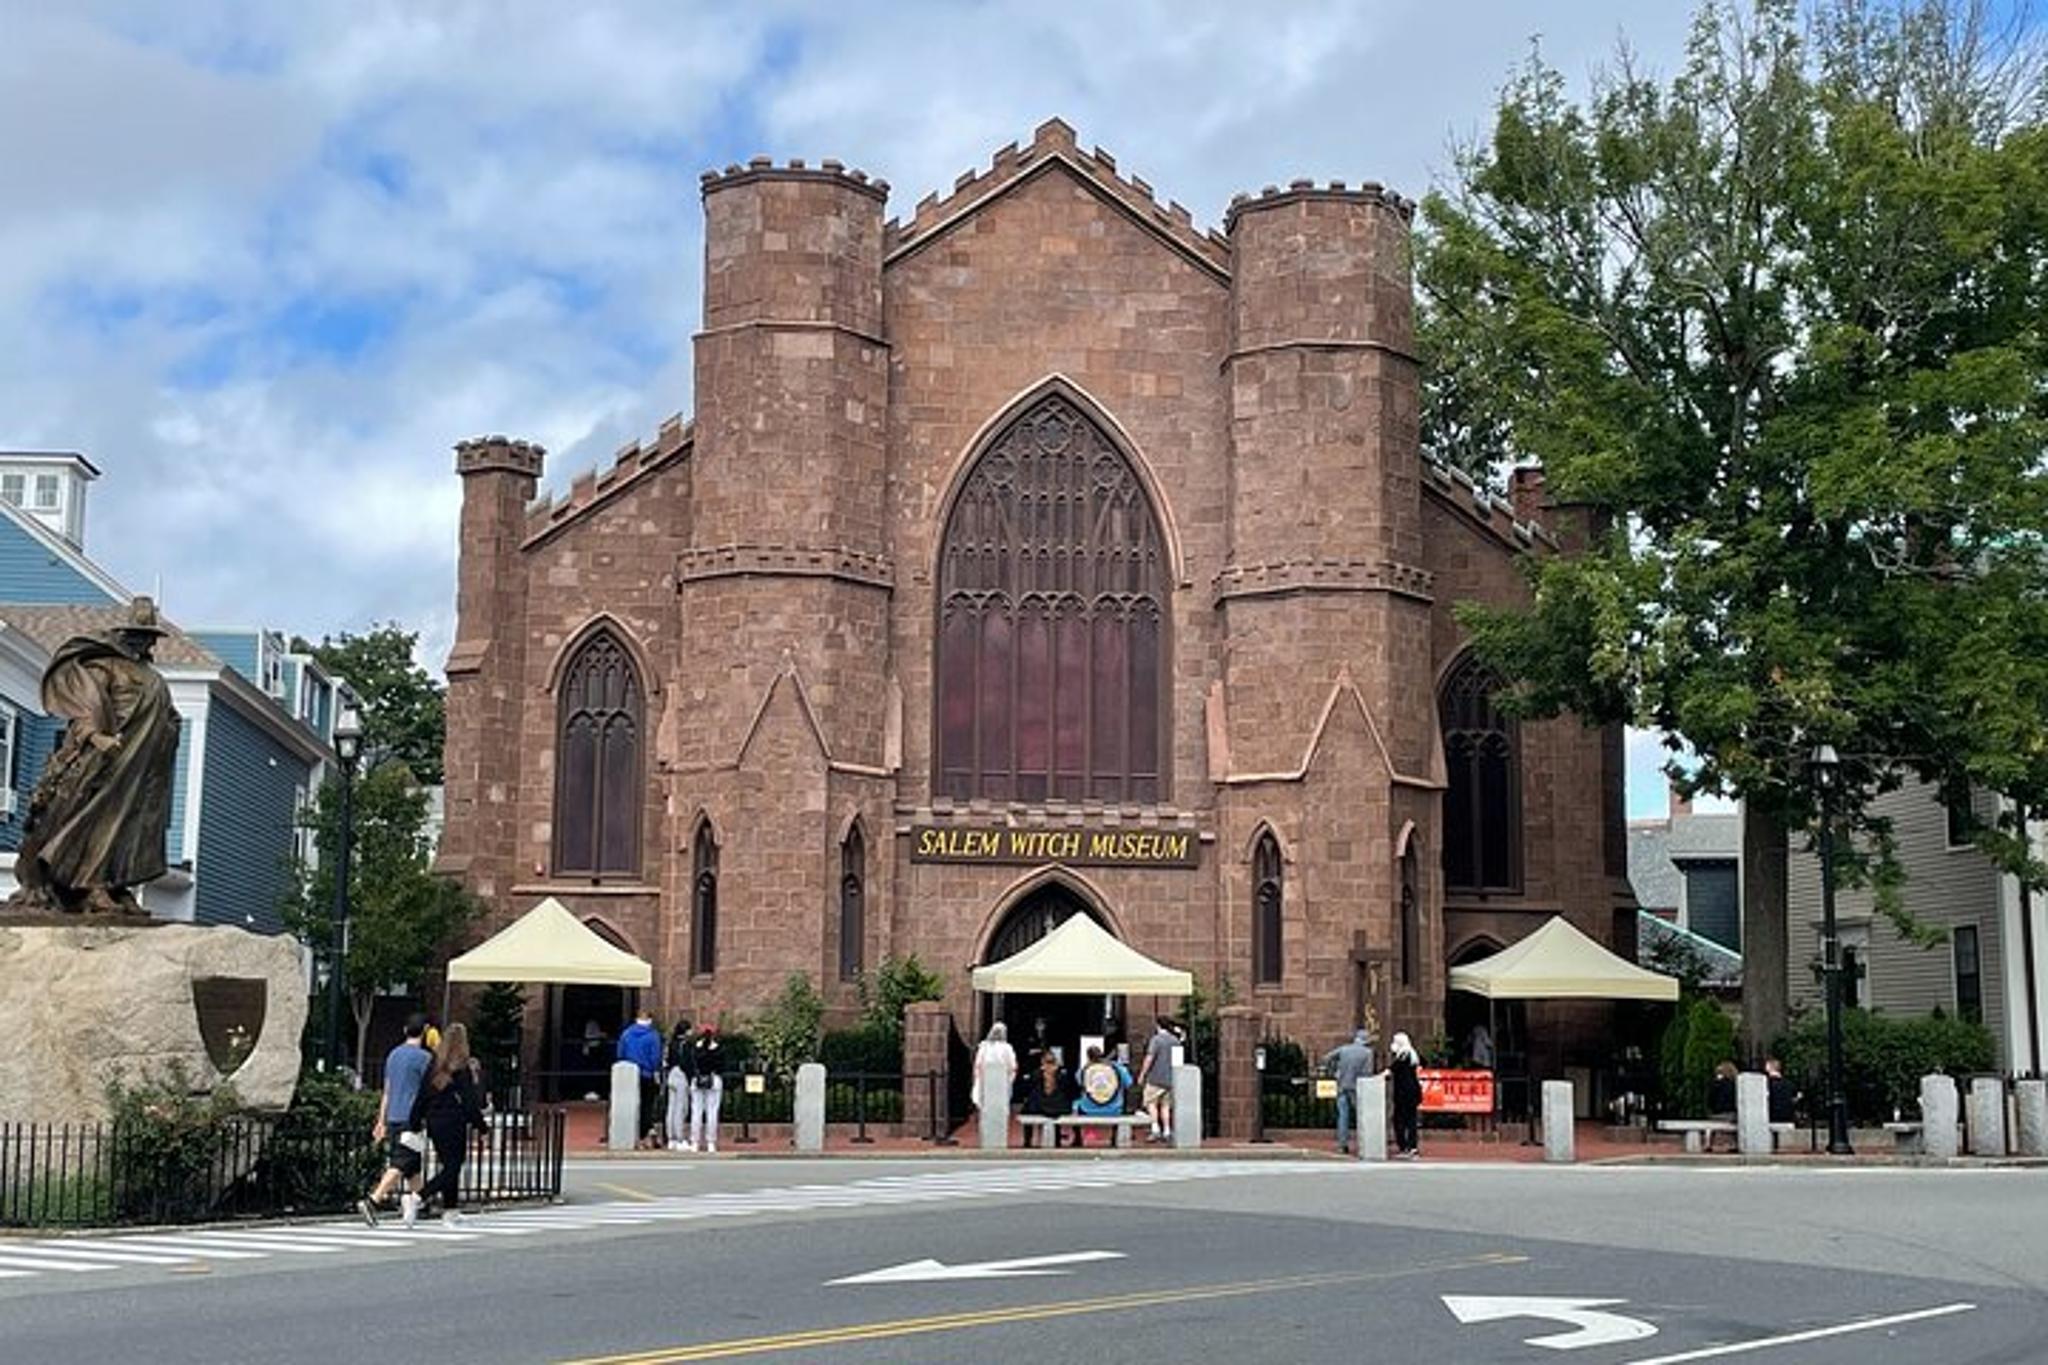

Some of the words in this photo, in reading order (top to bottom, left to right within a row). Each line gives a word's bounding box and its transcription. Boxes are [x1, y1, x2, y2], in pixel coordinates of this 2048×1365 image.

[917, 829, 1000, 857] SALEM
[1010, 830, 1081, 858] WITCH
[1089, 832, 1188, 860] MUSEUM
